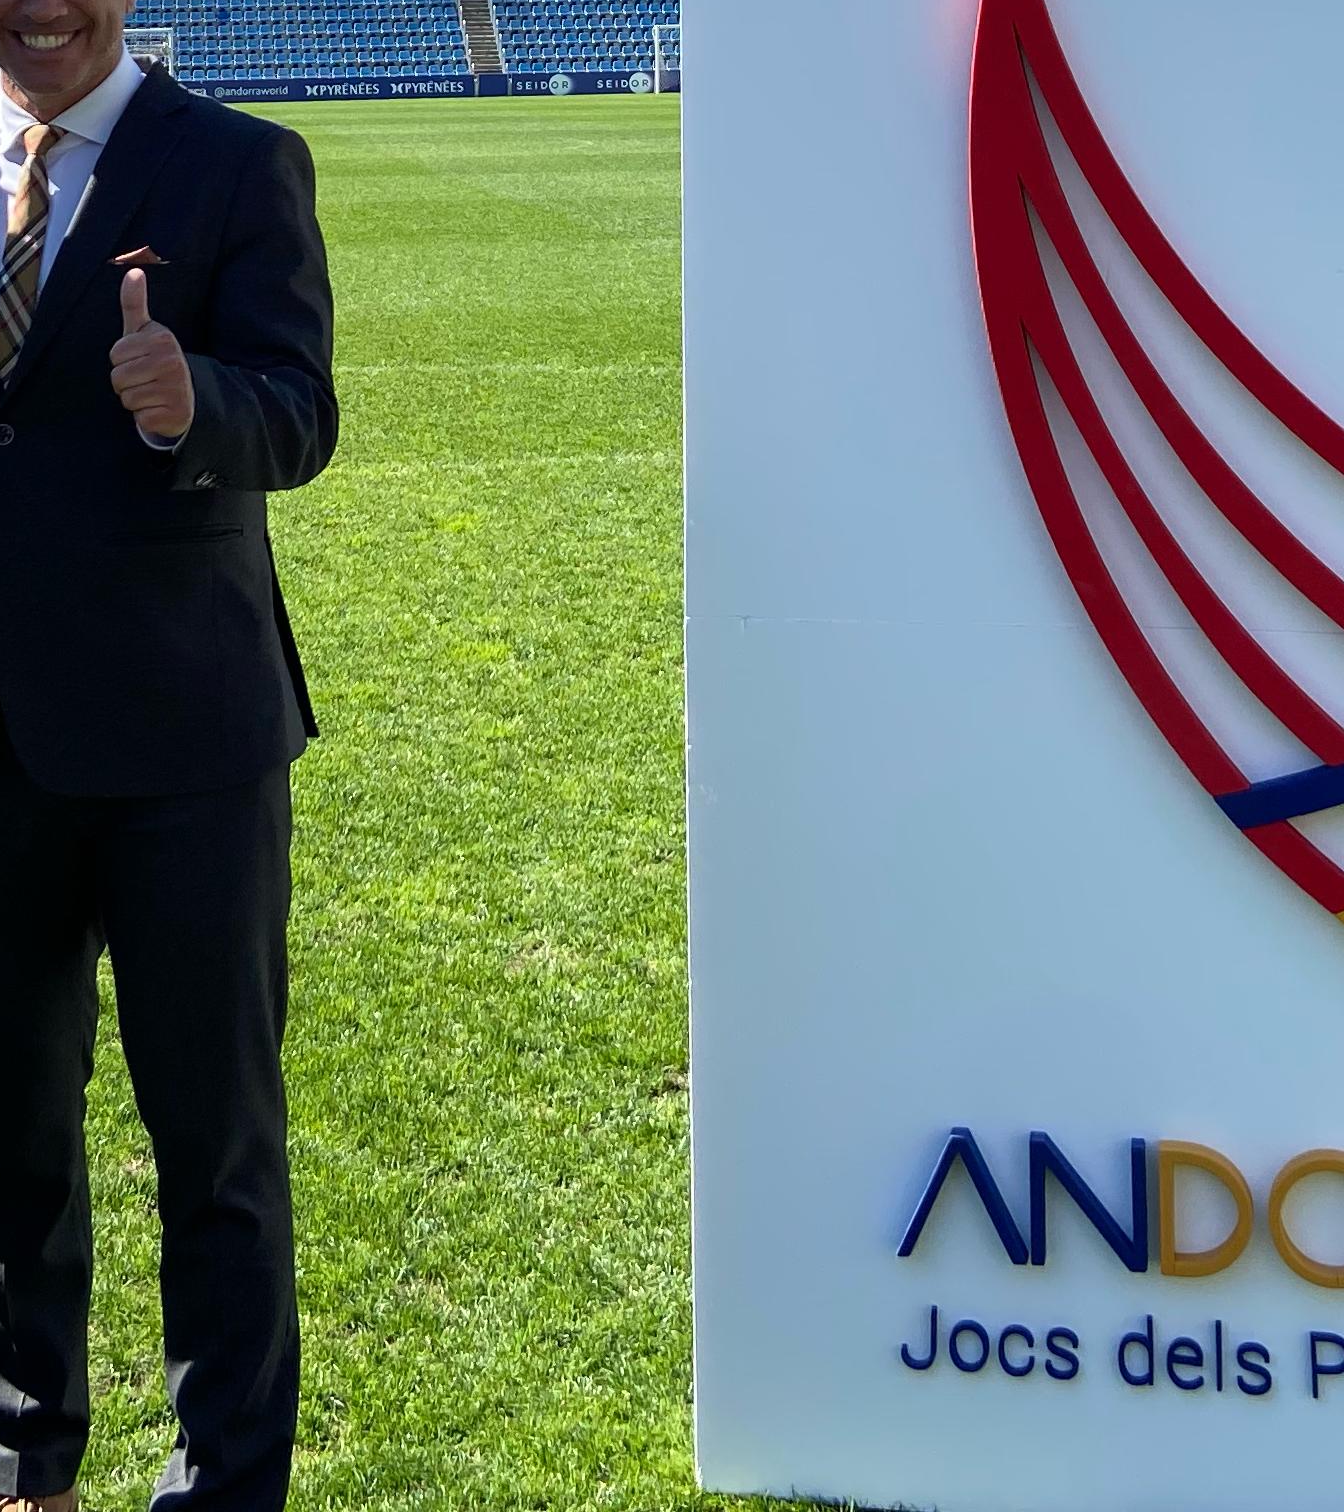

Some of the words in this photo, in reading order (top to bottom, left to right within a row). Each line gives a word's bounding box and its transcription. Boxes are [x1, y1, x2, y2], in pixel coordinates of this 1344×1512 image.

[516, 80, 569, 90] SEIDOR
[596, 78, 649, 88] SEIDOR
[214, 86, 288, 98] @andorraworld
[900, 1305, 1080, 1380] Jocs
[1117, 1314, 1272, 1396] dels
